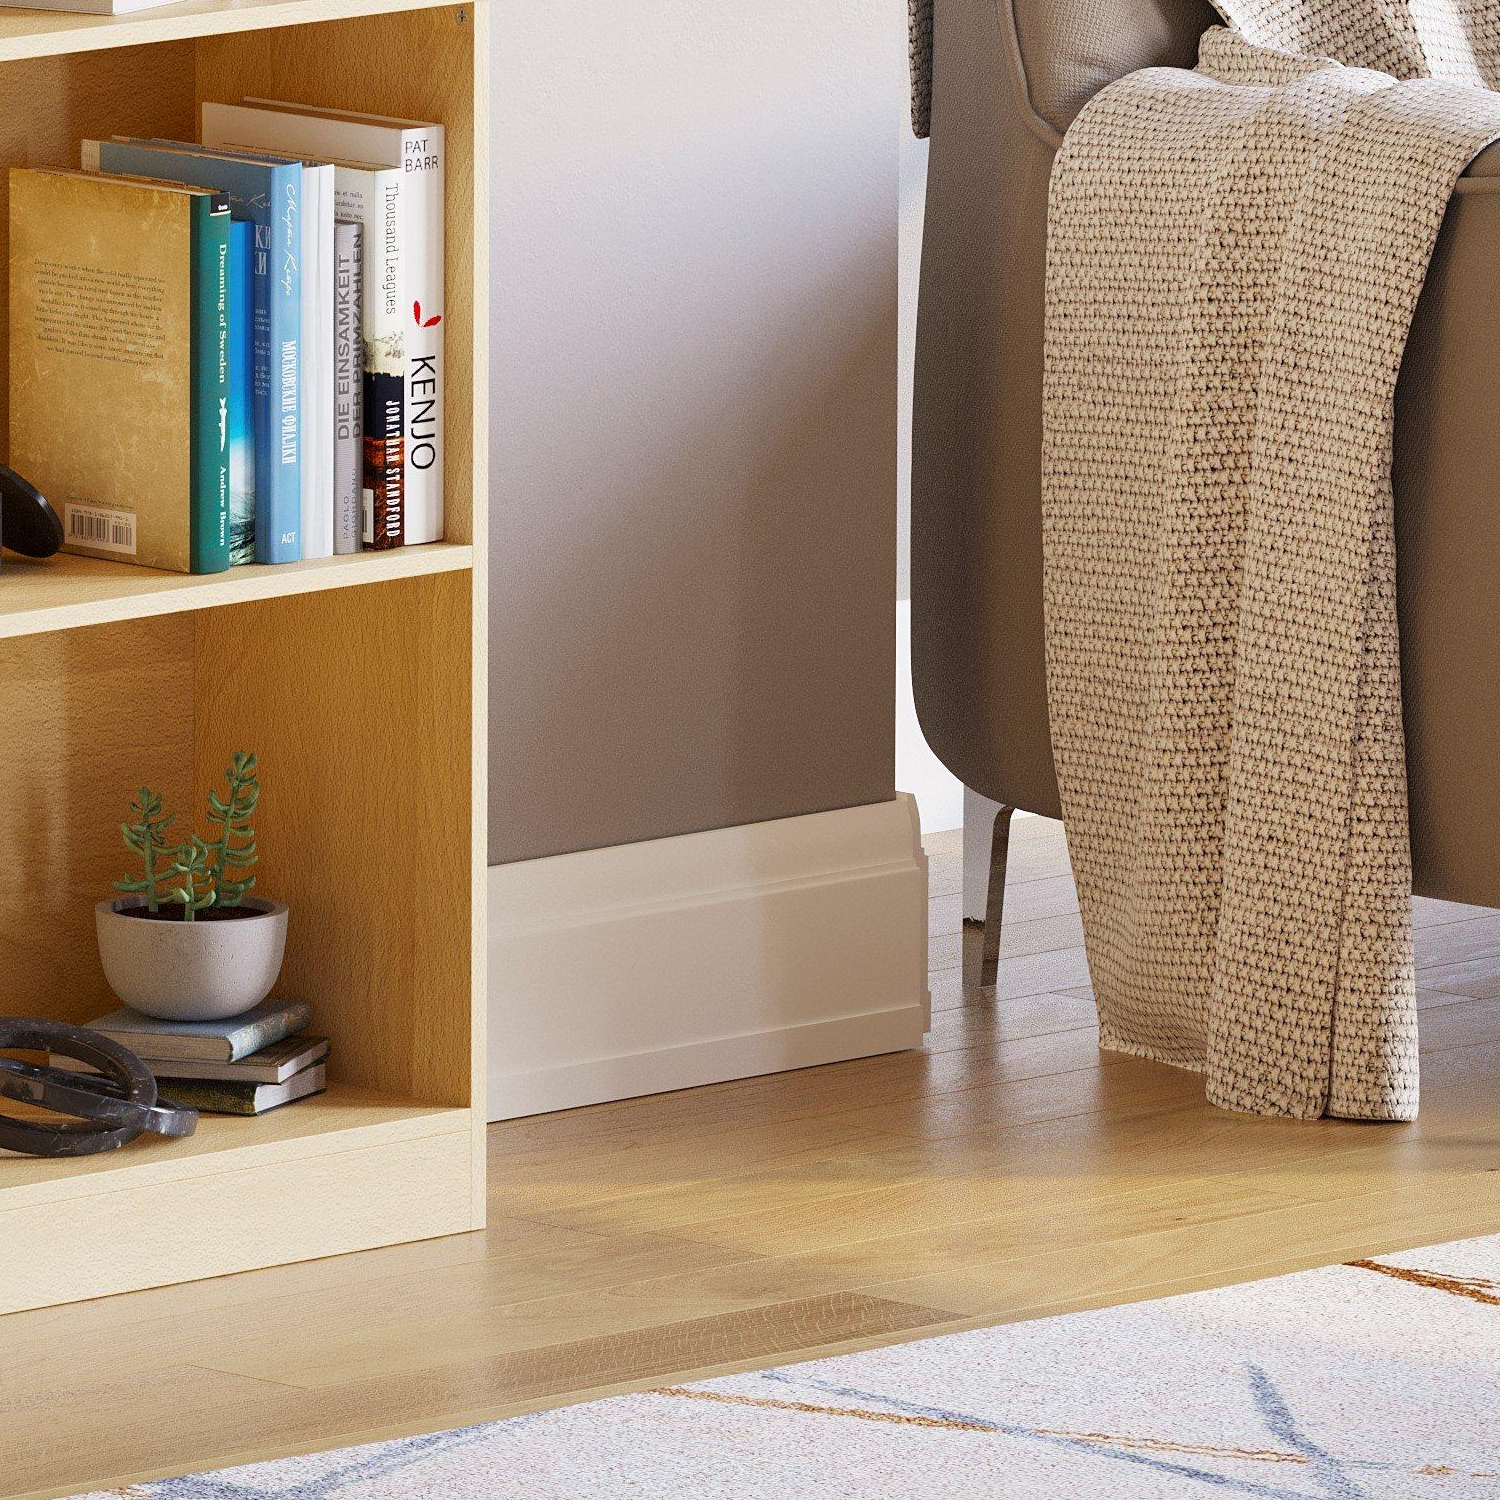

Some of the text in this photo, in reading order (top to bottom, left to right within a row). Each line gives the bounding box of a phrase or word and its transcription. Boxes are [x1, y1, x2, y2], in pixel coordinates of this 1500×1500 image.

[405, 139, 429, 154] PAT
[405, 155, 439, 173] BARR
[217, 243, 227, 384] Dreaming of Sweden
[382, 183, 400, 315] Thousand Leagues
[338, 254, 350, 440] DIE EINSAMKEIT
[352, 233, 362, 439] DER PRIMZAHLEN
[281, 339, 297, 465] МОСКОВСКИЕ ФИАЛКИ
[410, 355, 436, 470] KENJO
[219, 466, 227, 546] Andrew Brown
[385, 400, 400, 538] JONATHAN STANDFORD
